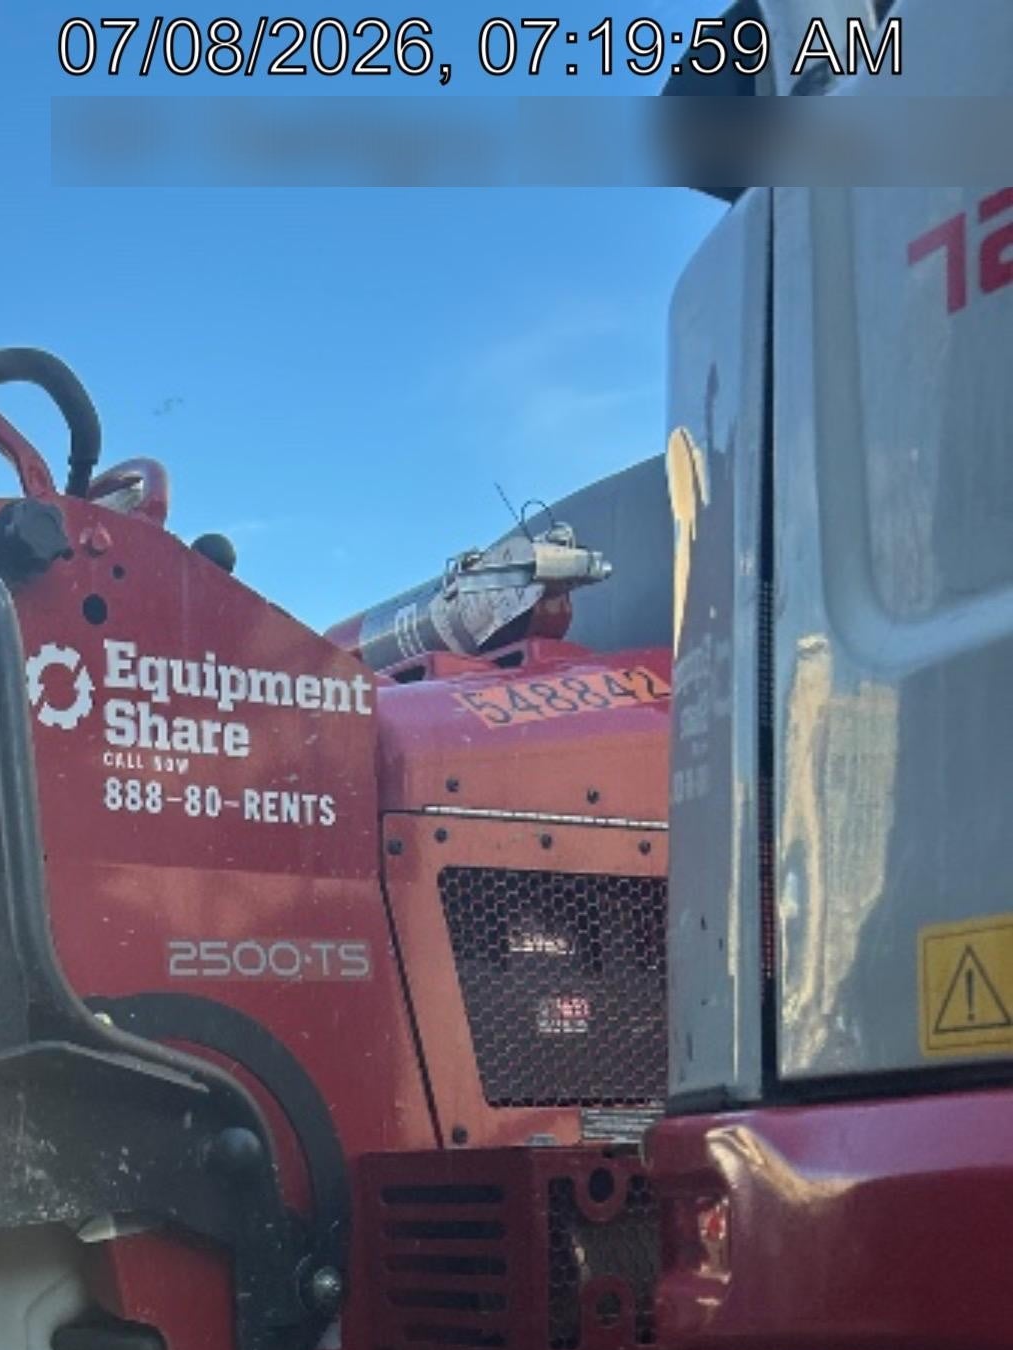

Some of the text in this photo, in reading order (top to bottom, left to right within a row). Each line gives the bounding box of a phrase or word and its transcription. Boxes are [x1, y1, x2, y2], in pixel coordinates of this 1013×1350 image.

[104, 638, 372, 715] Equipment
[104, 698, 251, 758] Share
[103, 751, 144, 770] CALL
[104, 776, 336, 827] 888-80-RENTS
